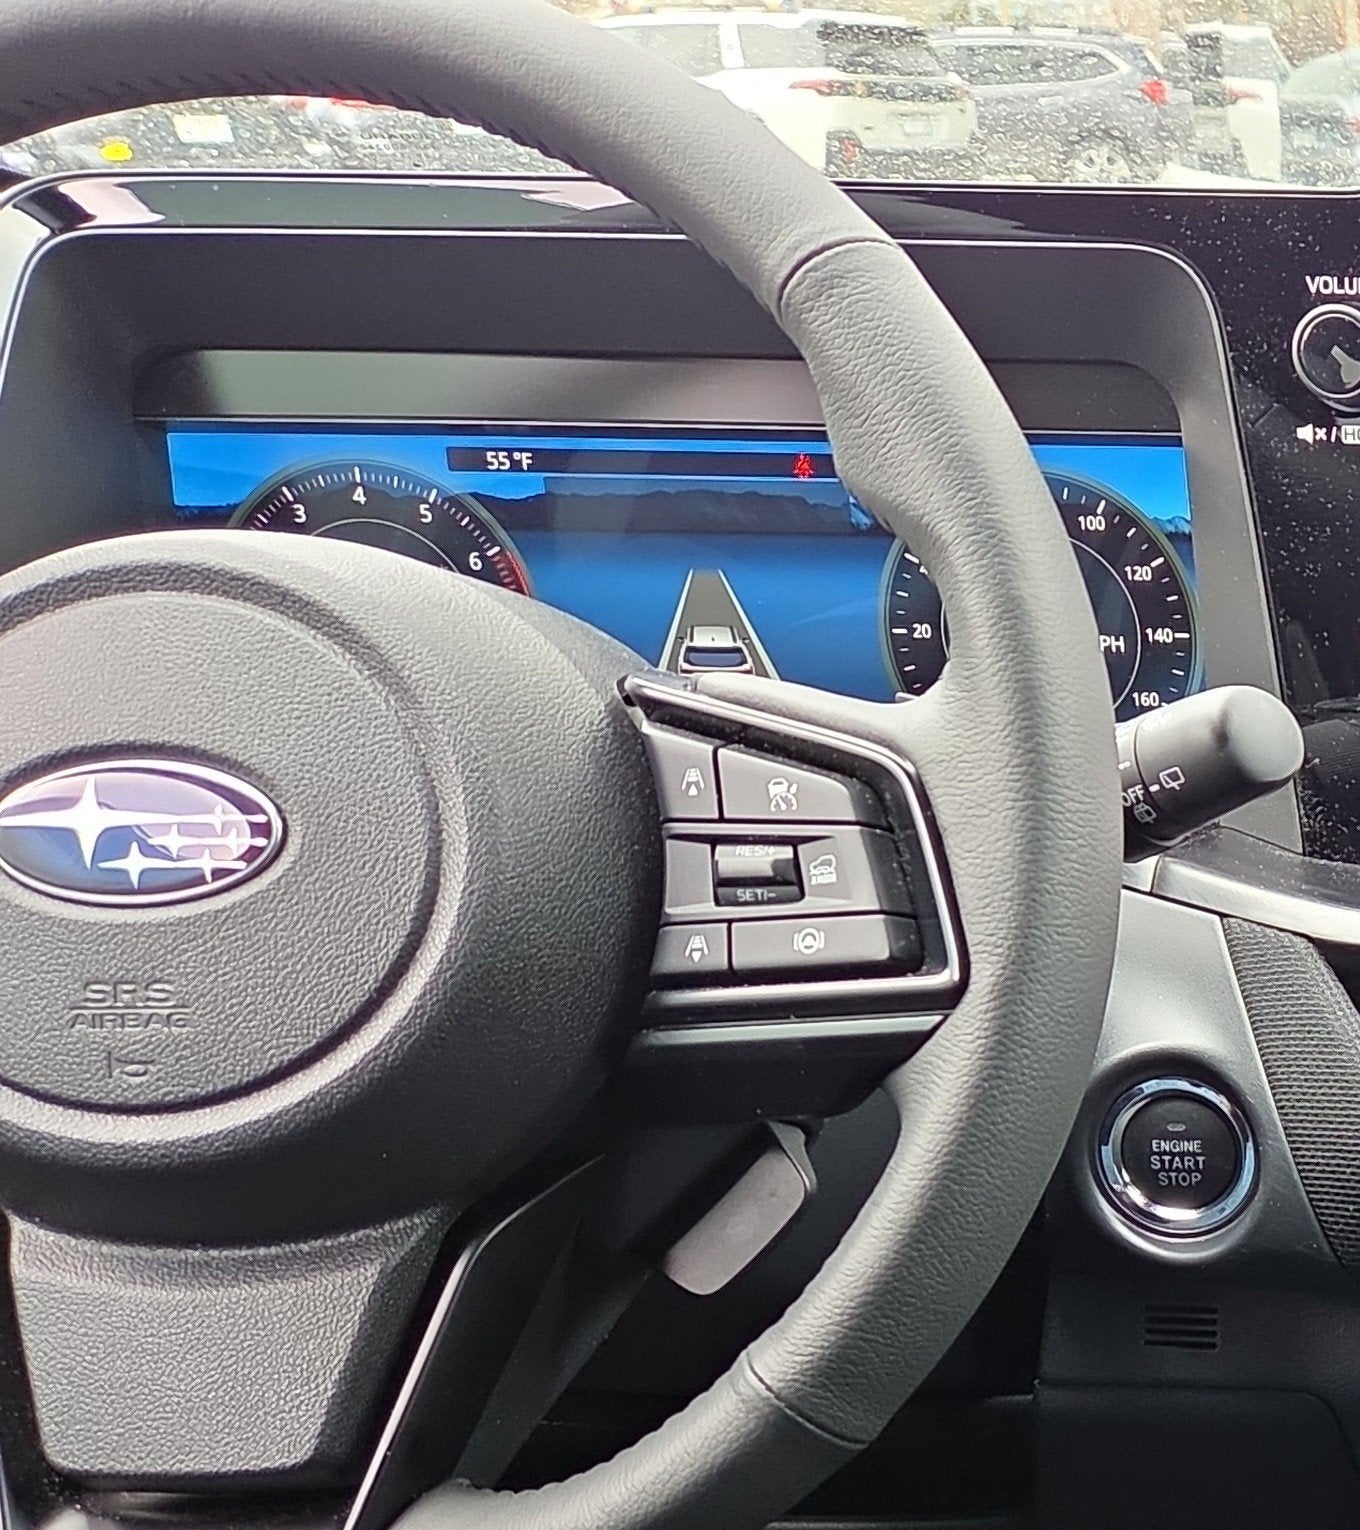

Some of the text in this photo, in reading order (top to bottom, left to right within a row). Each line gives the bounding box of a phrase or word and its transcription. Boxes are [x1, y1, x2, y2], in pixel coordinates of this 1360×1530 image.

[352, 486, 367, 506] 4
[293, 504, 307, 525] 3
[419, 503, 433, 524] 5
[1077, 515, 1106, 532] 100
[468, 551, 483, 572] 6
[1124, 566, 1152, 582] 120
[912, 622, 932, 639] 20
[1145, 627, 1173, 643] 140
[1099, 635, 1125, 653] PH
[1132, 691, 1160, 707] 160
[1151, 1139, 1202, 1153] ENGINE
[1150, 1155, 1206, 1170] START
[1158, 1172, 1202, 1187] STOP
